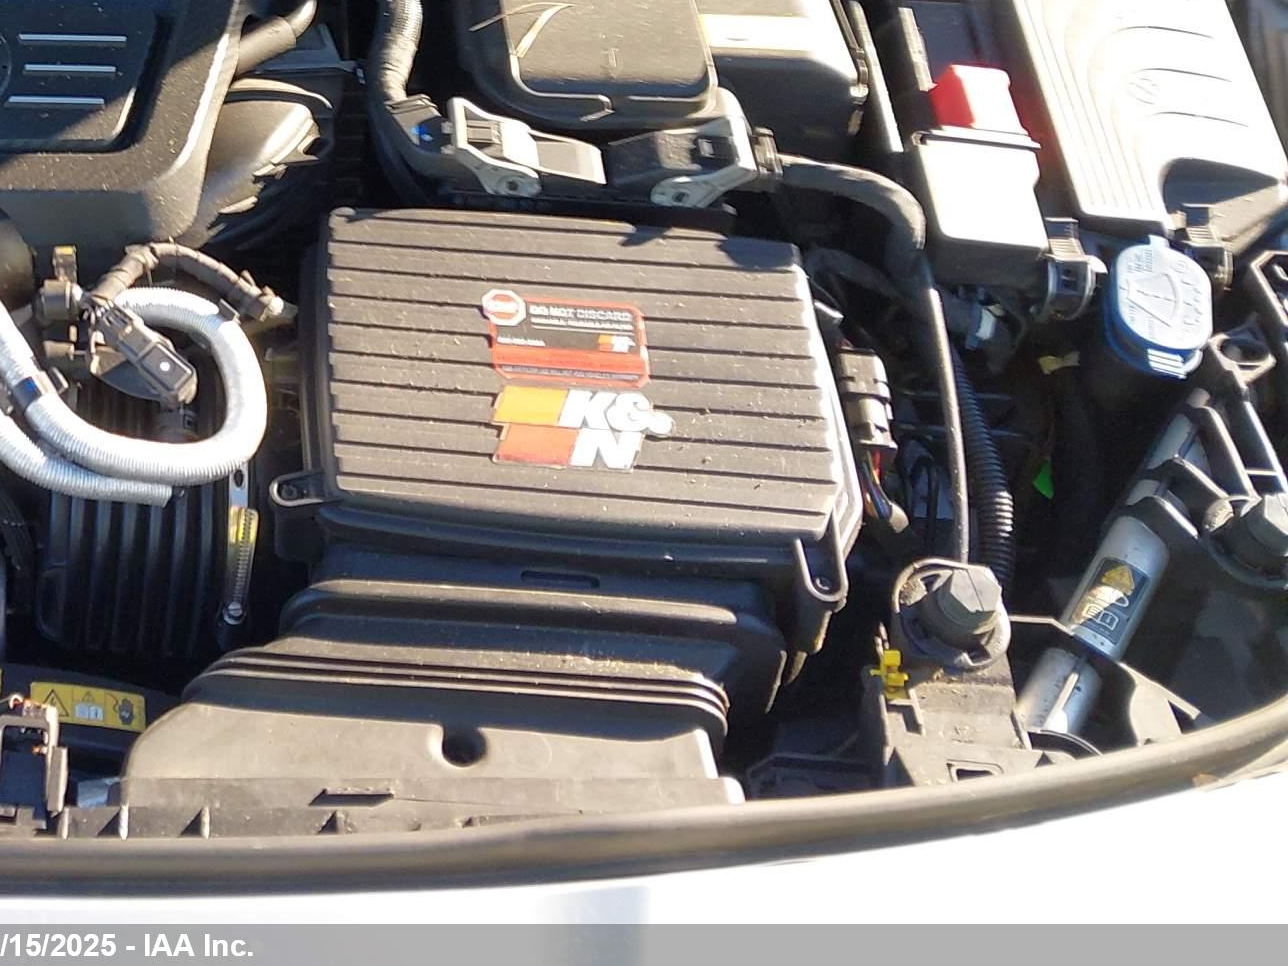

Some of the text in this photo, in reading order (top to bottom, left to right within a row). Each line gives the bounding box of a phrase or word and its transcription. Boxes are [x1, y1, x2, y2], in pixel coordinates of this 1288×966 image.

[529, 304, 549, 315] DO
[550, 306, 575, 318] NOT
[576, 308, 634, 322] DISCARD
